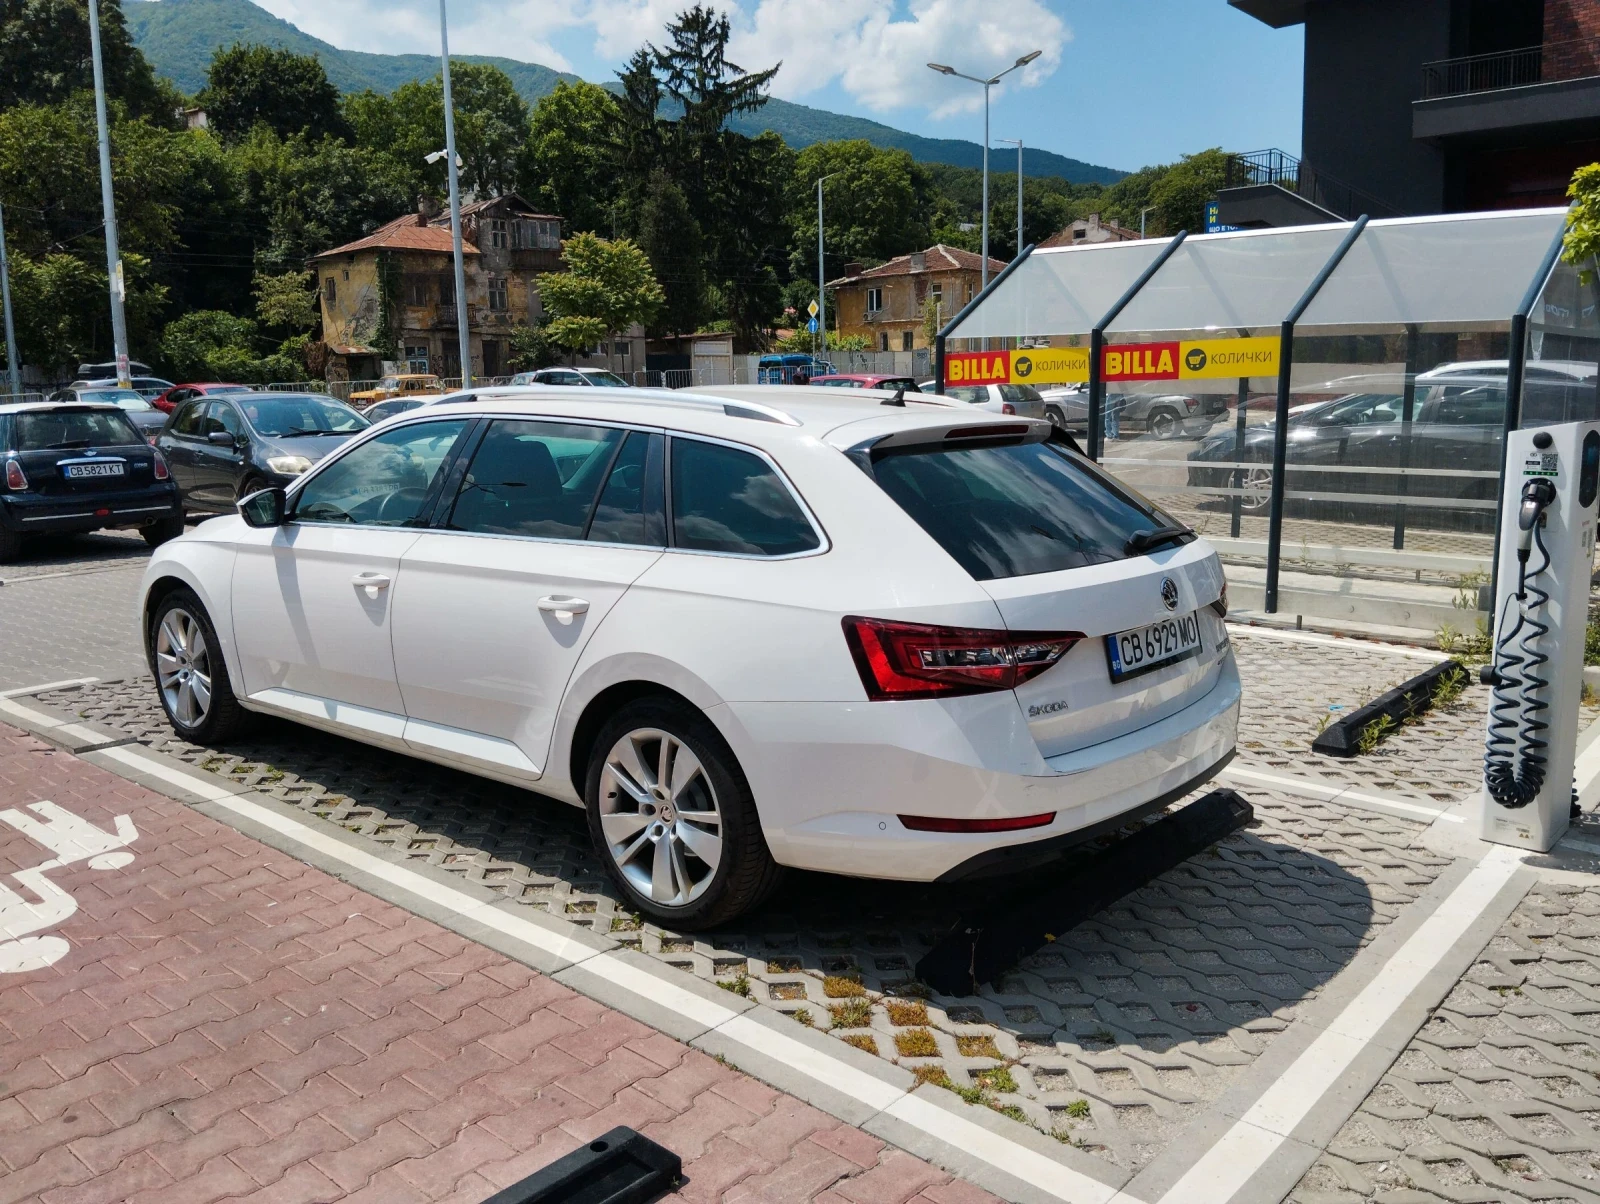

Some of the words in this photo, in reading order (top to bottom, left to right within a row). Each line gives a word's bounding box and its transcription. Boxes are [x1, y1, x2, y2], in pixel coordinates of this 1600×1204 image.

[1035, 359, 1086, 371] КОЛИЧКИ
[1105, 349, 1174, 375] BILLA
[1210, 351, 1272, 365] КОЛИЧКИ
[948, 357, 1006, 381] BILLA
[70, 467, 84, 476] CB
[85, 466, 107, 475] 5821
[108, 464, 121, 474] KT
[1121, 634, 1143, 666] CB
[1145, 622, 1178, 658] 6929
[1177, 616, 1197, 648] MO
